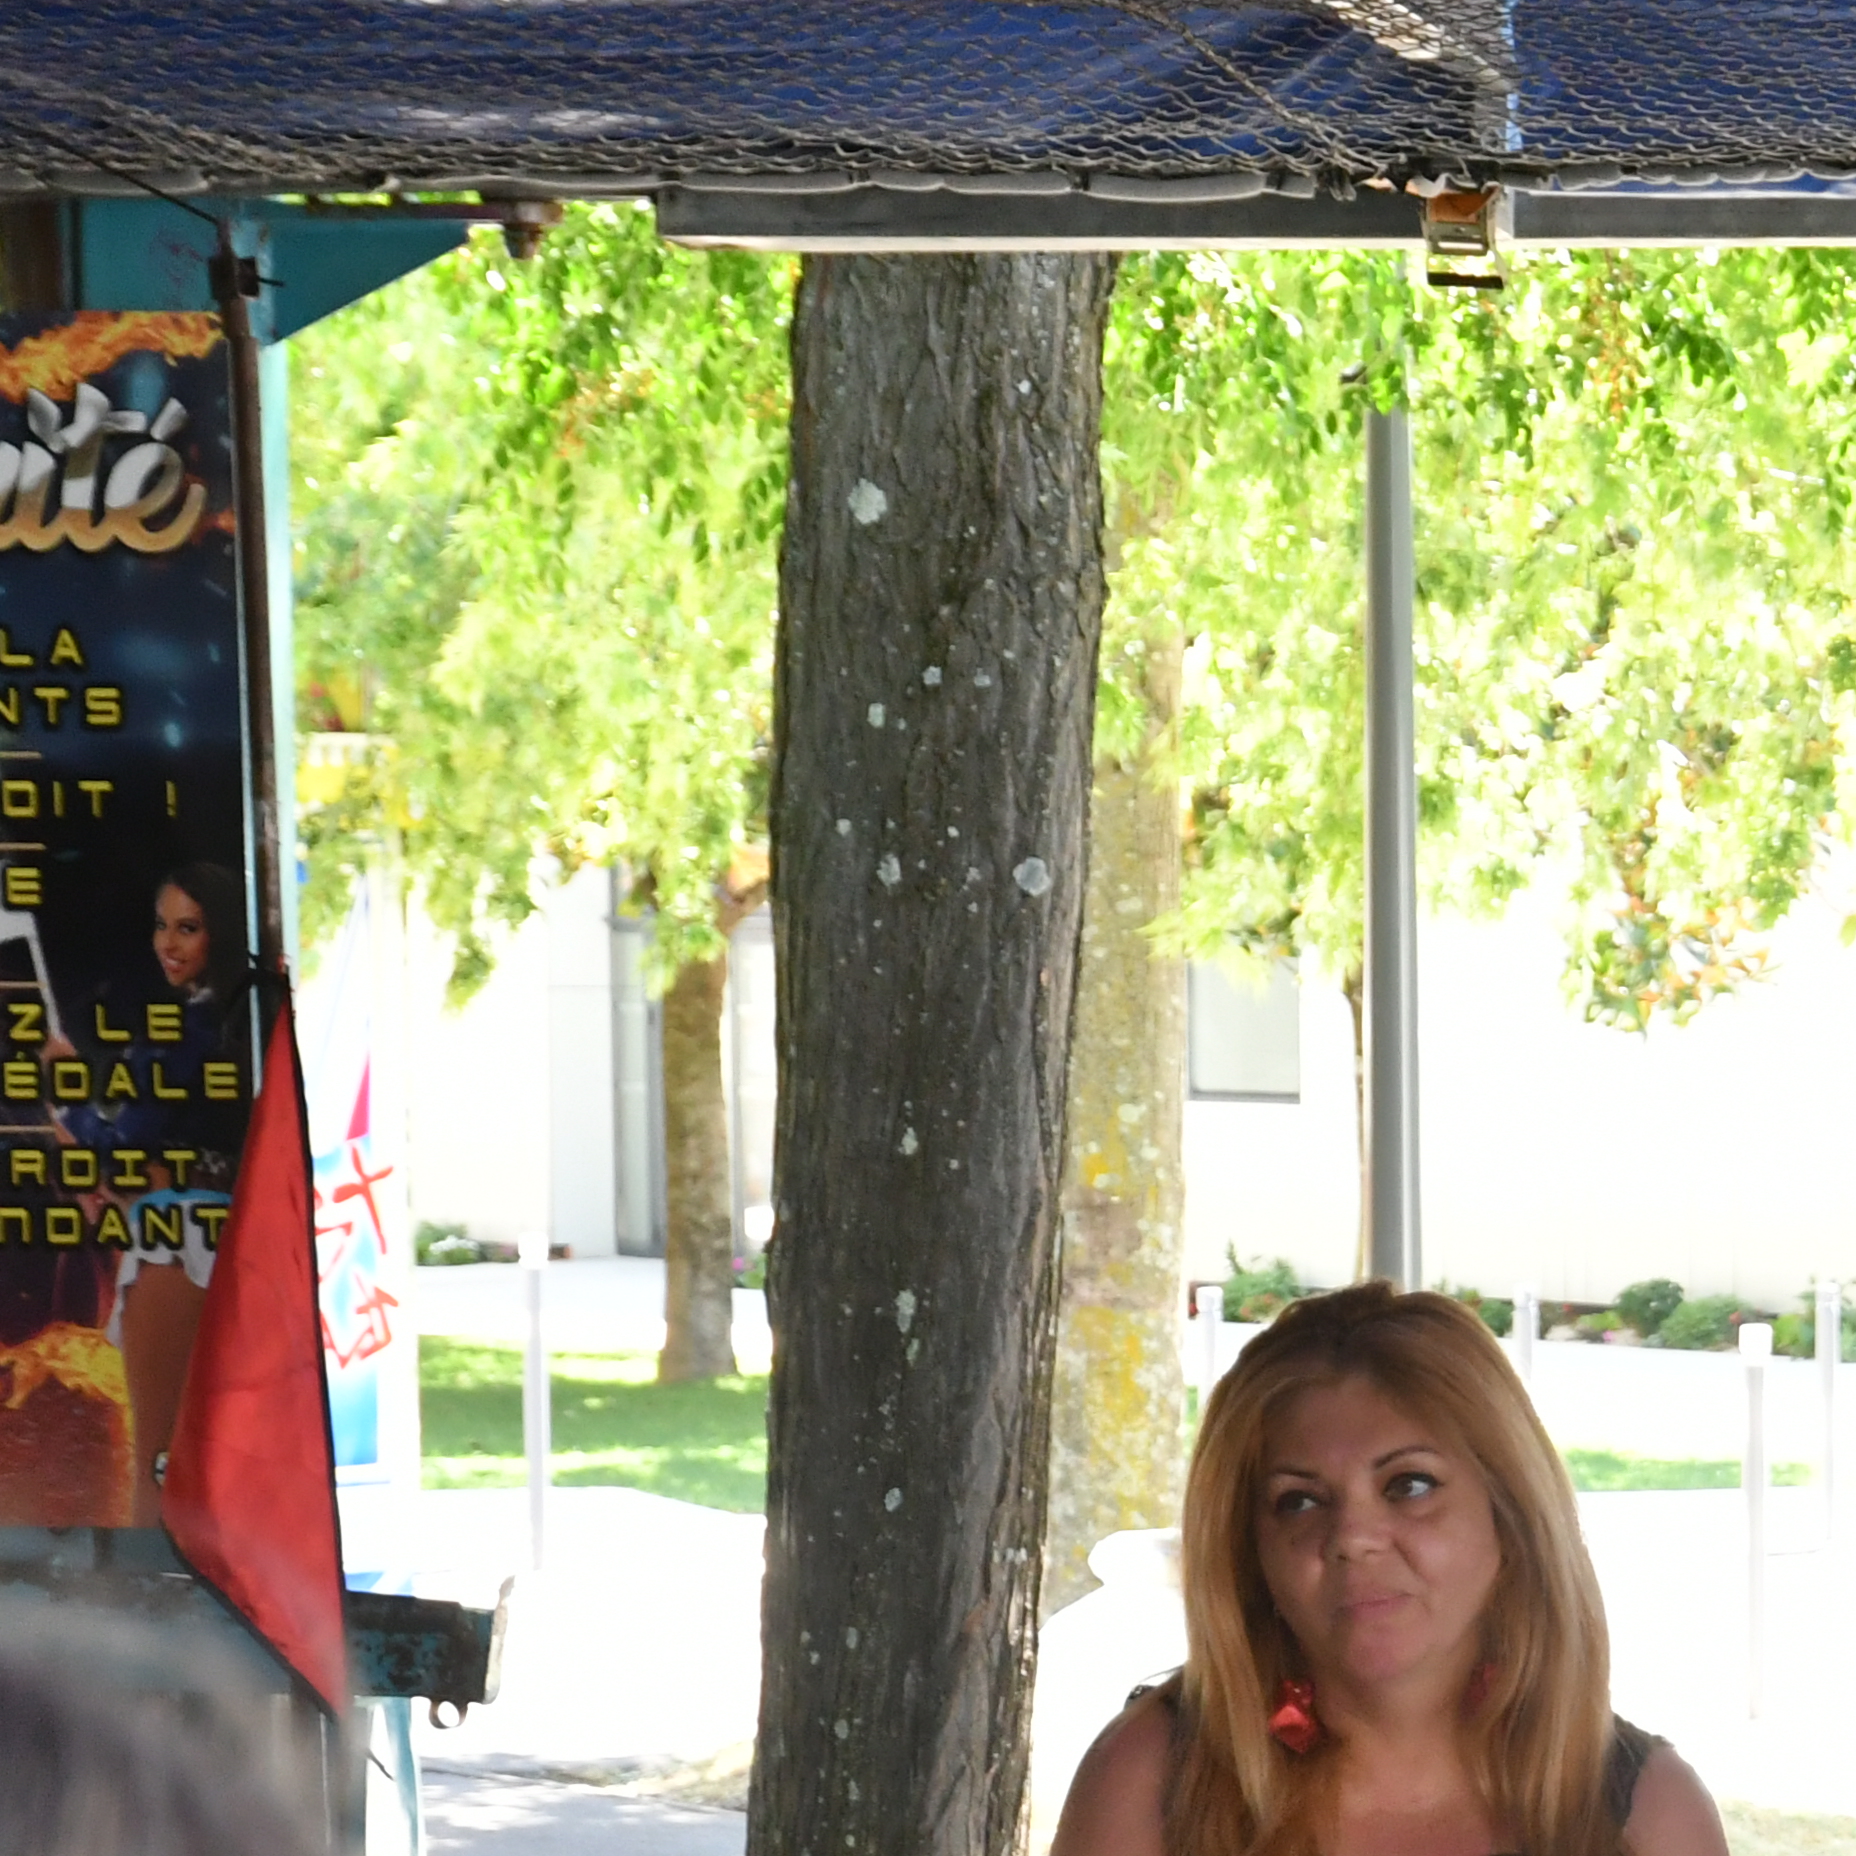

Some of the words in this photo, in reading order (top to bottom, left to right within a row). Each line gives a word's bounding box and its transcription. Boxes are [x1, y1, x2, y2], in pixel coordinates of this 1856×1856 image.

[0, 628, 84, 668] LA
[6, 867, 42, 905] E
[7, 1003, 44, 1042] Z
[96, 1003, 183, 1042] LE
